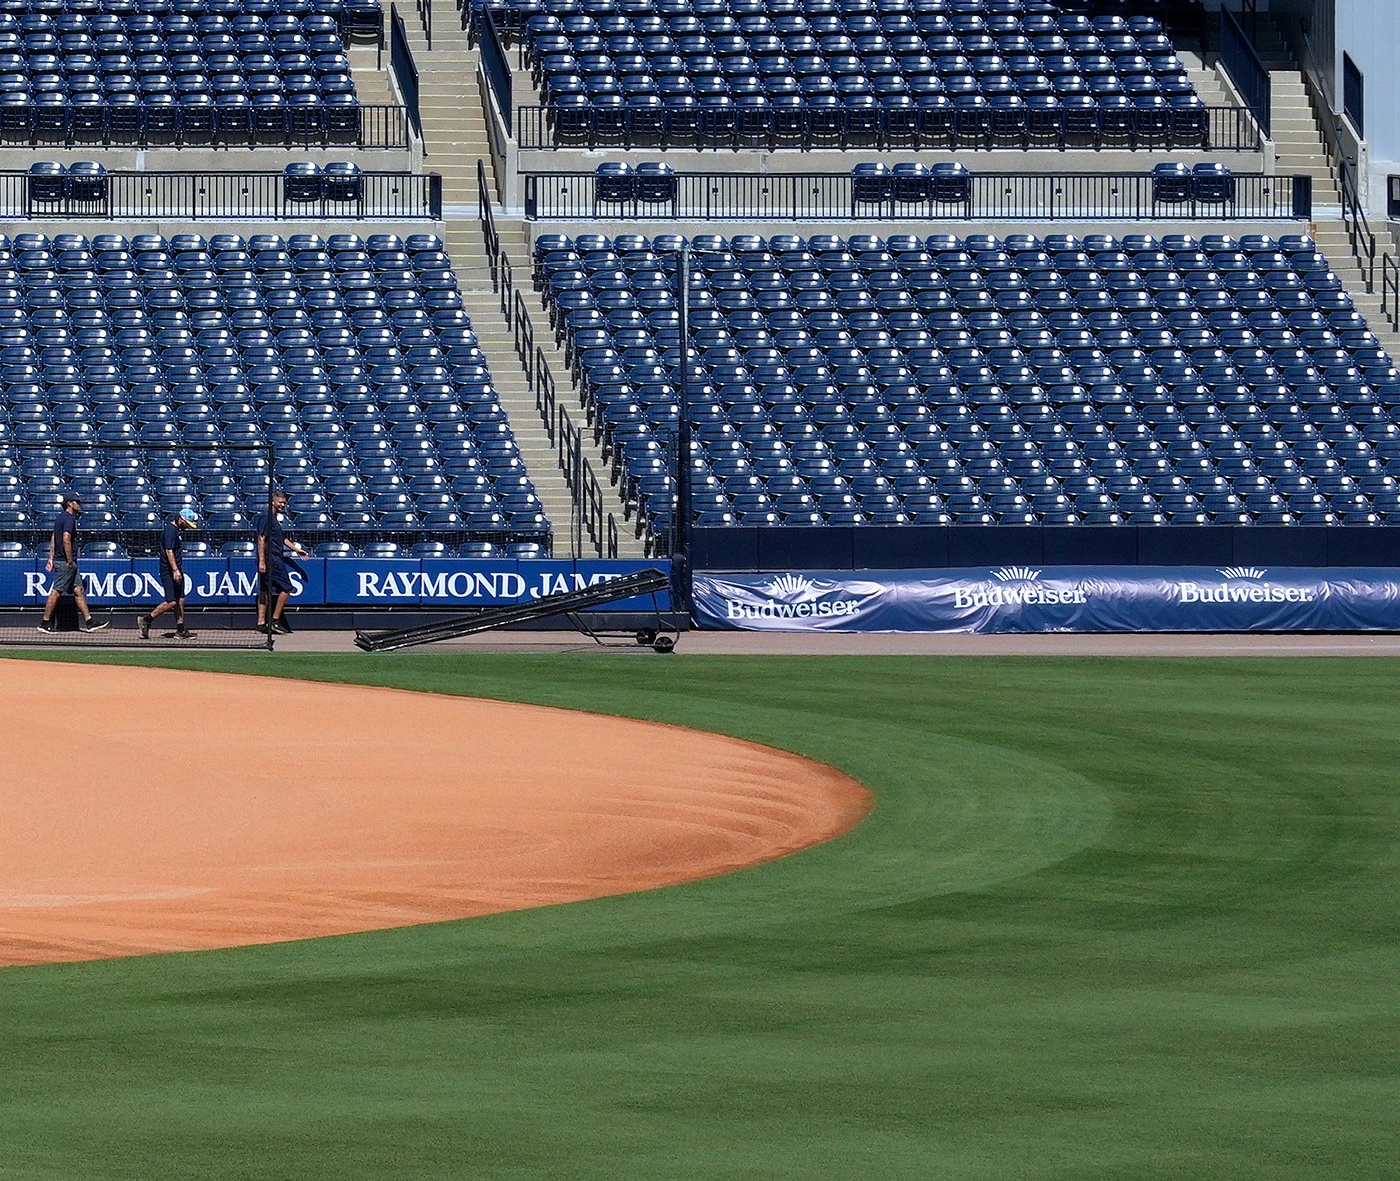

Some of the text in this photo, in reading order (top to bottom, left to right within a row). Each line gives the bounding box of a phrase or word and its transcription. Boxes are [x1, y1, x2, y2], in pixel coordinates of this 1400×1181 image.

[24, 571, 303, 597] RMON JAMS
[356, 572, 526, 598] RAYMOND
